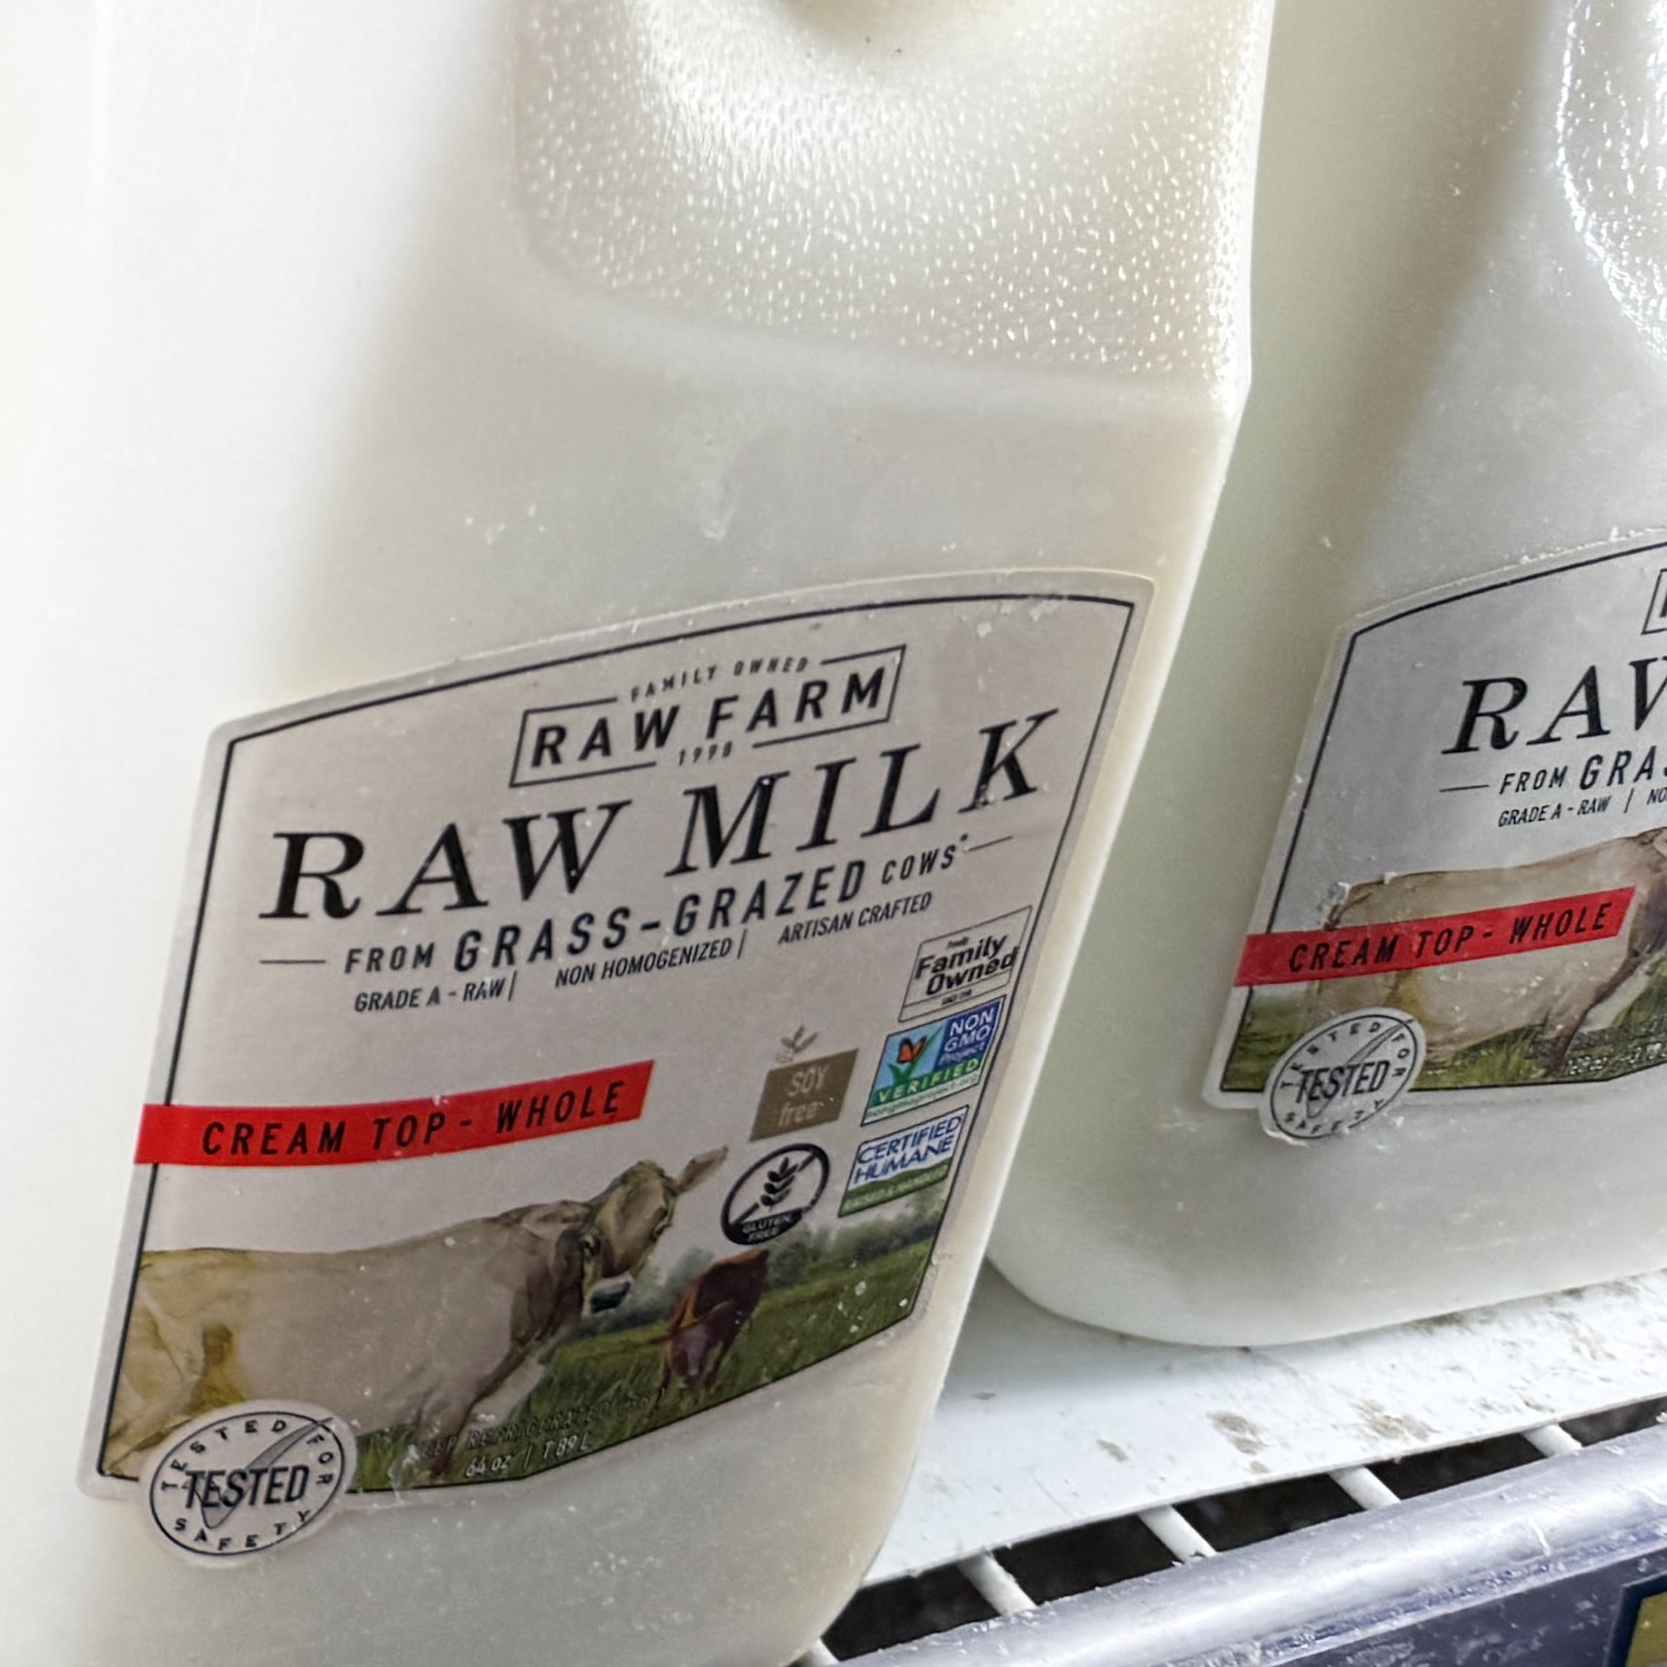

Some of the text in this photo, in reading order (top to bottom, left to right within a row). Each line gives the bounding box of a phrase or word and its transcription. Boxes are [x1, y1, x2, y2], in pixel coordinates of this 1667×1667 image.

[630, 665, 718, 703] FAMILY
[530, 666, 886, 768] RAW FARM
[1499, 764, 1569, 795] FROM
[257, 707, 1060, 920] RAW MILK
[1497, 803, 1551, 828] GRADE
[1549, 802, 1563, 820] A
[1576, 795, 1613, 817] RAW
[344, 941, 436, 974] FROM
[453, 859, 867, 974] GRASS-GRAZED
[1289, 901, 1614, 974] CREAM TOP WHOLE
[354, 891, 934, 1013] GRADE A RAW NON HOMOGENIZED ARTISAN CRAFTED
[914, 933, 1009, 981] Family
[924, 944, 1020, 997] Owned
[943, 1024, 991, 1054] GMO
[948, 1007, 996, 1038] NON
[783, 1064, 828, 1098] SOY
[877, 1057, 980, 1105] VERIFIED
[1293, 1058, 1392, 1105] TESTED
[201, 1079, 626, 1158] CREAM TOP WHOLE
[777, 1100, 821, 1129] free
[852, 1135, 953, 1186] HUMANE
[856, 1115, 963, 1165] CERTIFIED
[161, 1417, 288, 1492] TESTED
[491, 1454, 511, 1471] oz
[183, 1464, 309, 1509] TESTED
[173, 1508, 312, 1552] SAFETY
